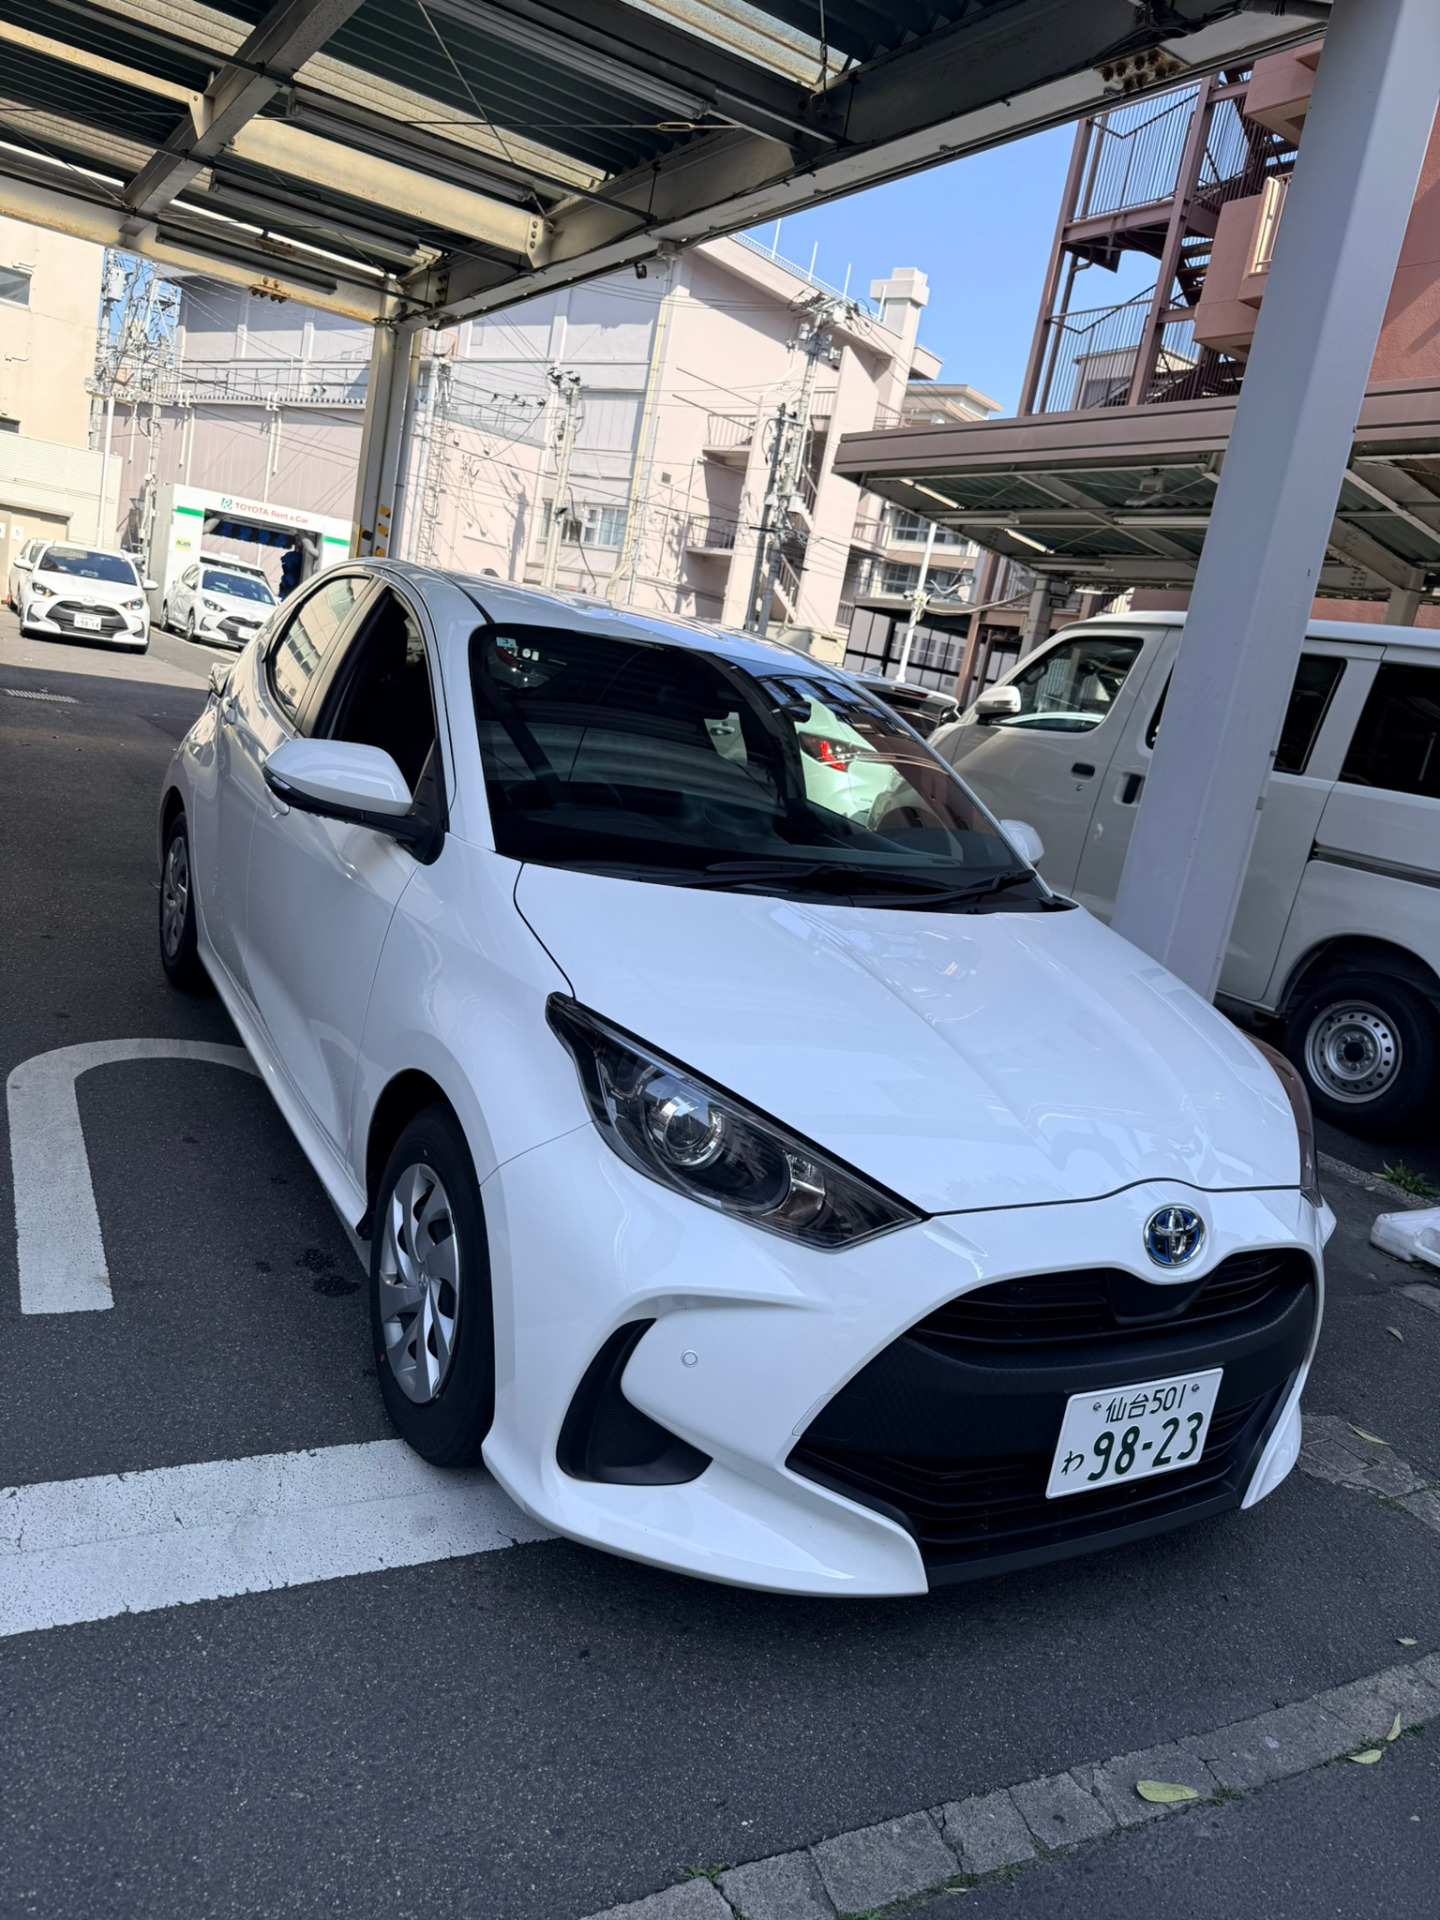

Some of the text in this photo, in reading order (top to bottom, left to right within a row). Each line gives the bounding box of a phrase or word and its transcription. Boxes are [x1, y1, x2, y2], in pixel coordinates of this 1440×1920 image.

[235, 502, 269, 516] TOYOTA
[271, 510, 288, 520] Rent
[295, 515, 309, 524] Car
[1060, 1411, 1204, 1482] わ 98-23
